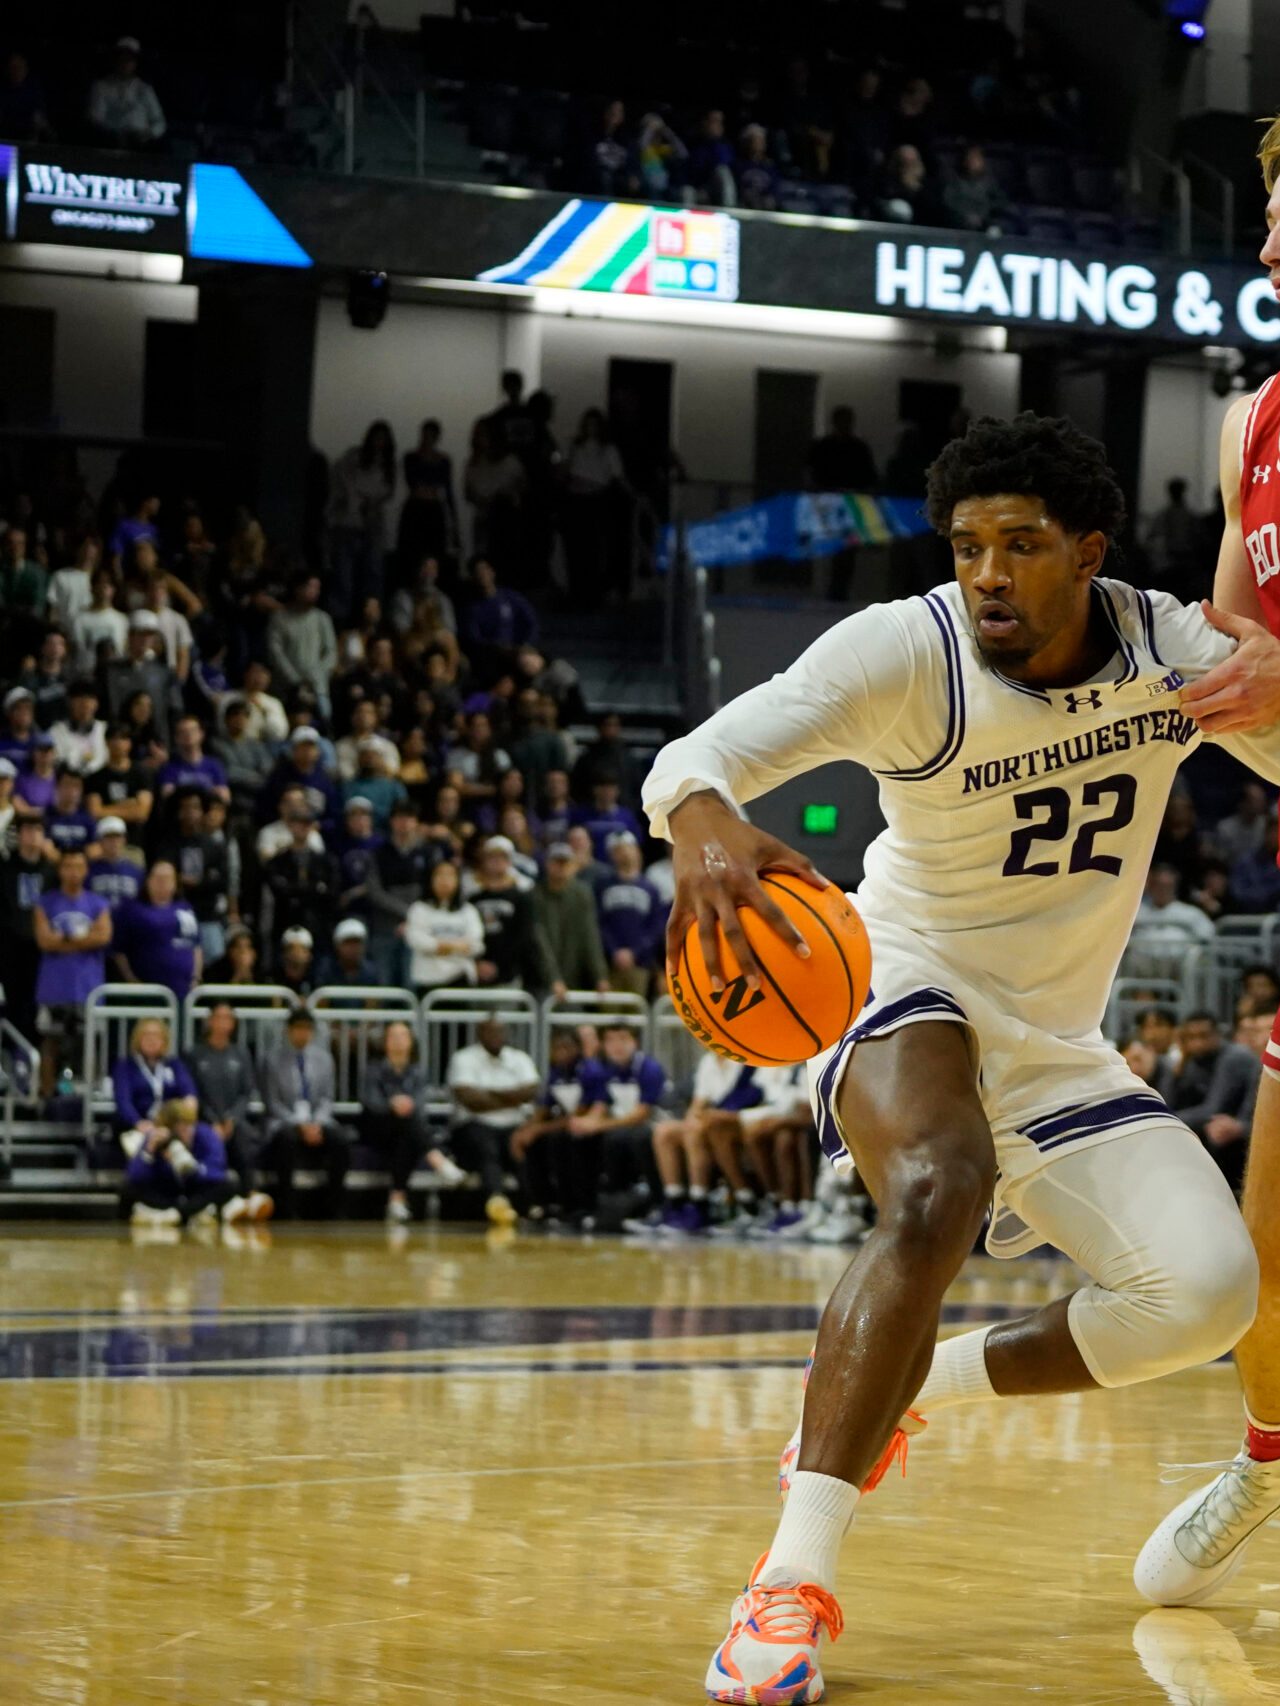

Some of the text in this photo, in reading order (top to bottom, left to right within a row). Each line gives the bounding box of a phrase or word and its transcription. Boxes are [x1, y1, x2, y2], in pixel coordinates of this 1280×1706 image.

[26, 163, 182, 208] WINTRUST
[876, 242, 1157, 330] HEATING
[1173, 271, 1223, 336] &
[962, 708, 1201, 794] NORTHWESTERN
[1002, 773, 1138, 877] 22
[670, 973, 748, 1064] Wilso
[709, 974, 766, 1022] N
